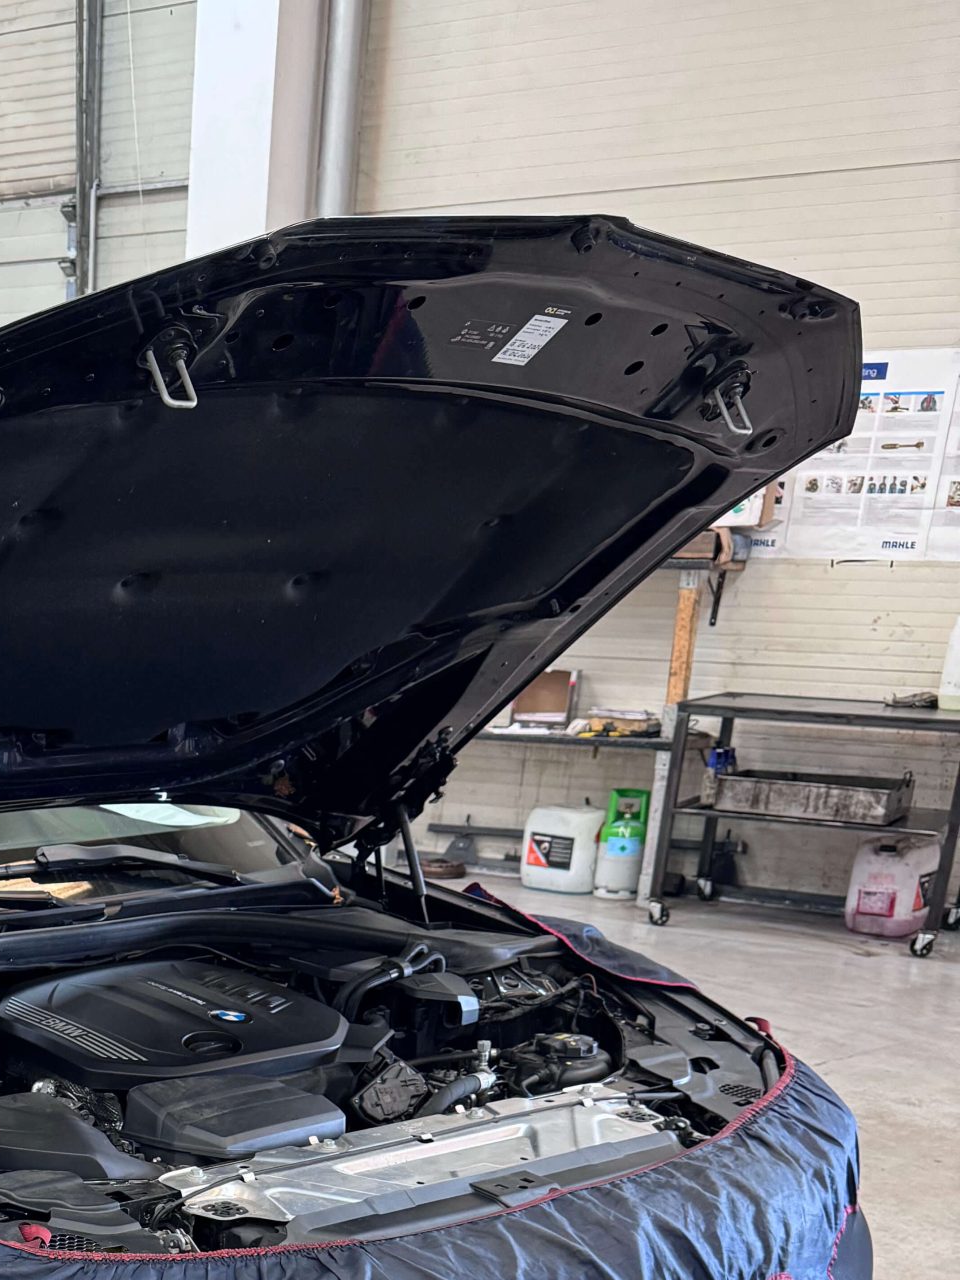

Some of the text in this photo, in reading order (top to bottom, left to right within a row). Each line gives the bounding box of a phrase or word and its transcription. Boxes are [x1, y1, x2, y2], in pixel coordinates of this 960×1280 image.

[749, 539, 776, 548] AHLE
[881, 541, 917, 549] MAHLE
[41, 1018, 88, 1037] BMW
